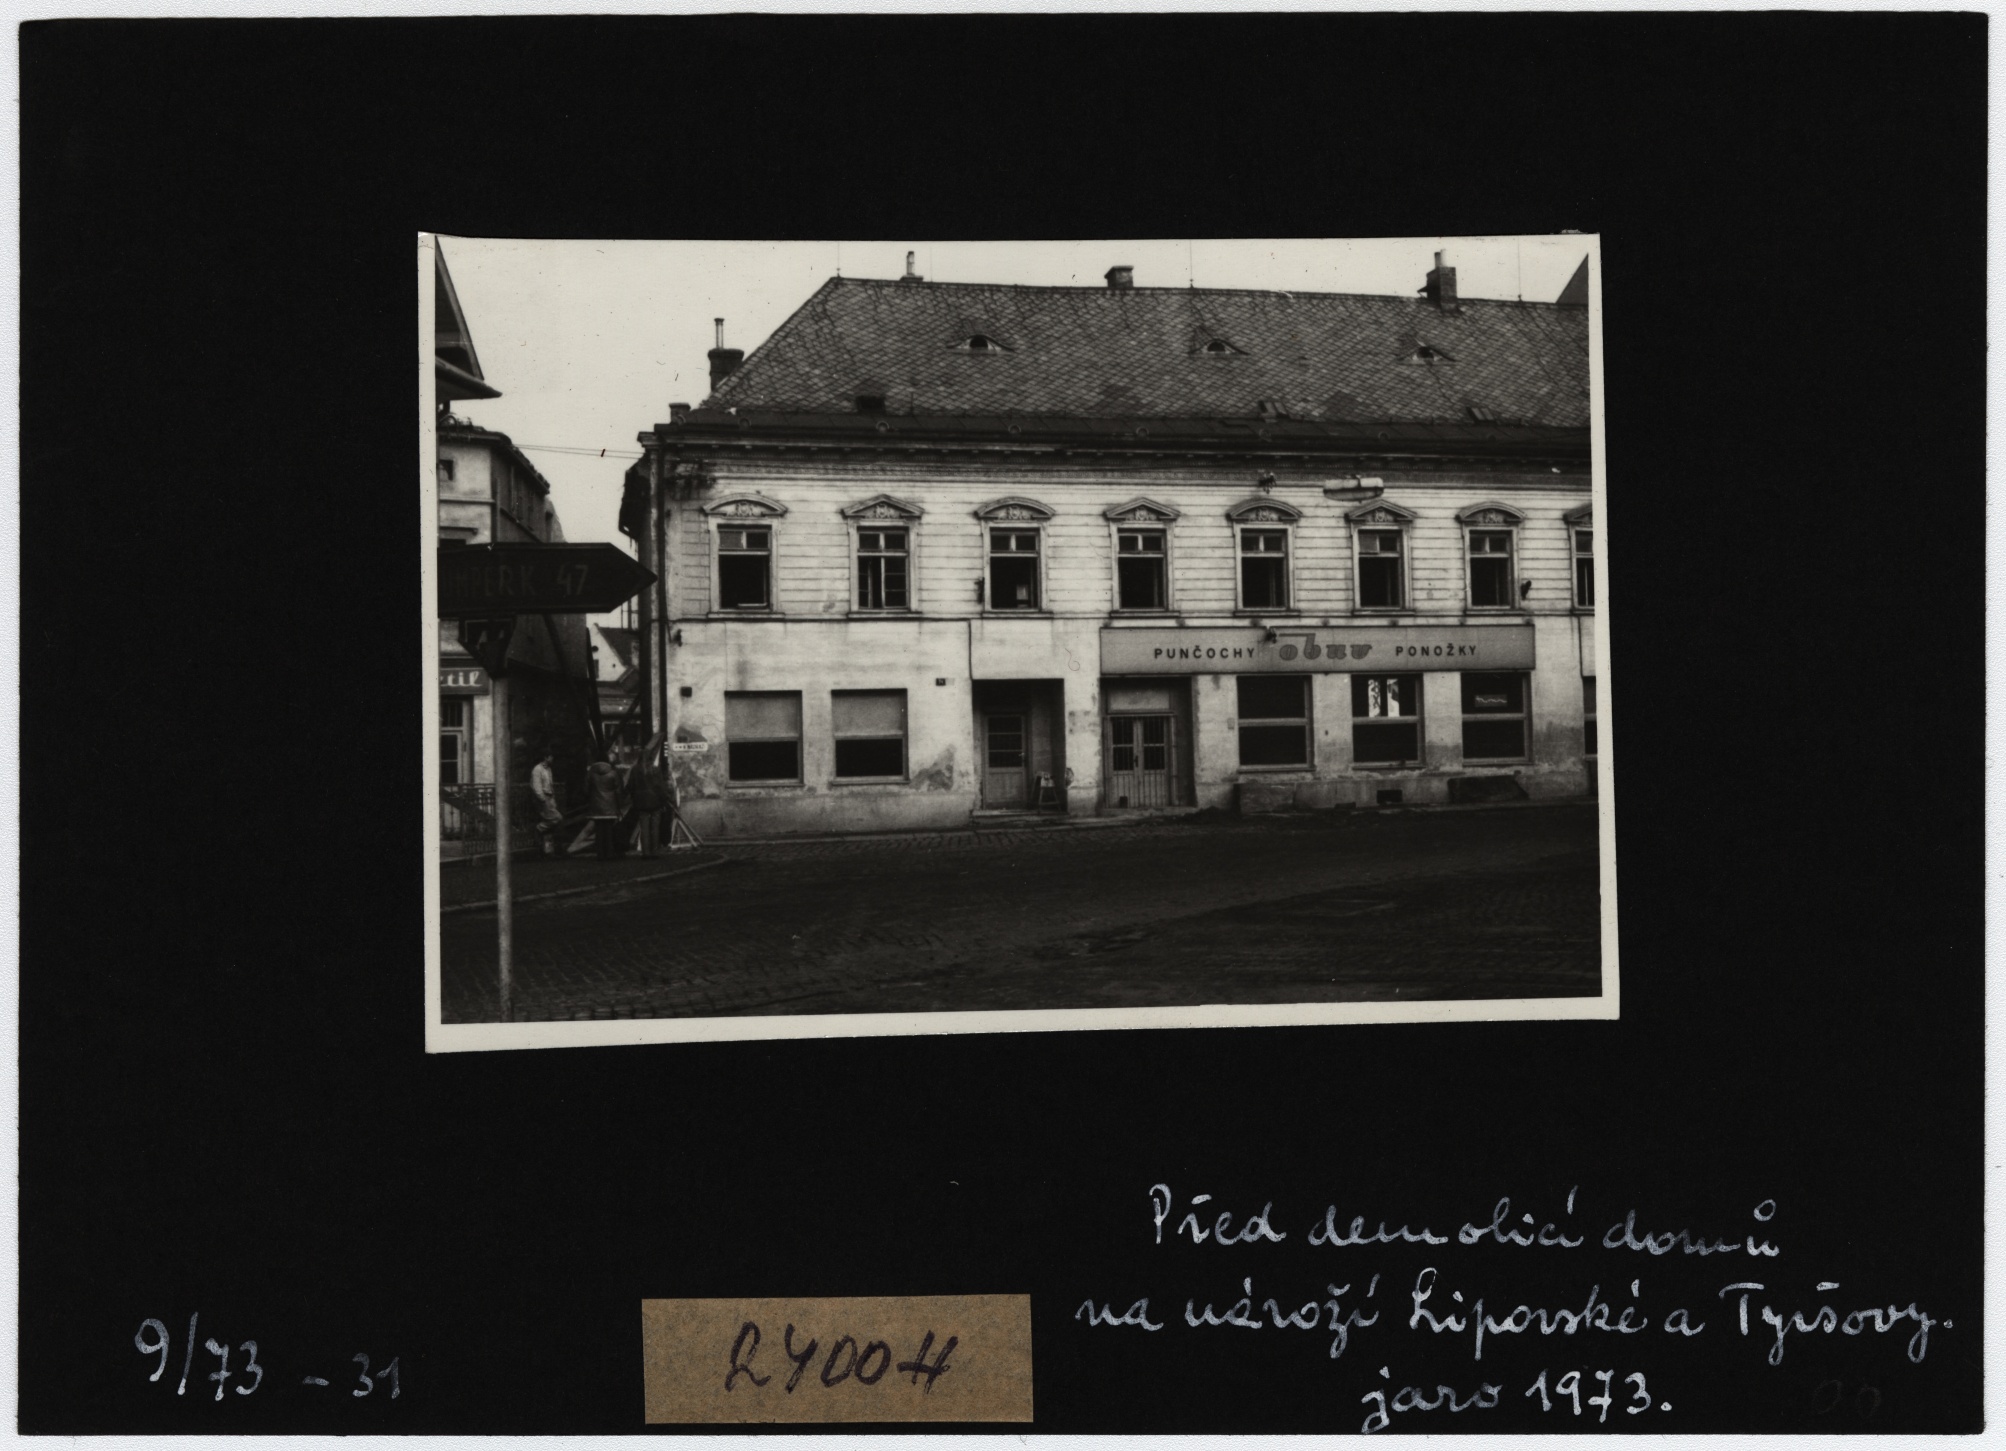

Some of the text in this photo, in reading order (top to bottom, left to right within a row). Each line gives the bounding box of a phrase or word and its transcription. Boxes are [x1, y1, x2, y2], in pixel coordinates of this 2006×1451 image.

[556, 561, 589, 595] 47
[1153, 645, 1255, 660] PUNČOCHY
[1278, 633, 1373, 661] obuv
[1396, 643, 1477, 657] PONOŽKY
[1148, 1183, 1781, 1258] Před demolicí domů
[1074, 1296, 1164, 1332] na
[1183, 1274, 1381, 1359] nároží
[1408, 1266, 1650, 1361] Lipovské
[1663, 1307, 1706, 1337] a
[134, 1311, 264, 1402] 9/73
[1360, 1365, 1673, 1434] jaro 1973.
